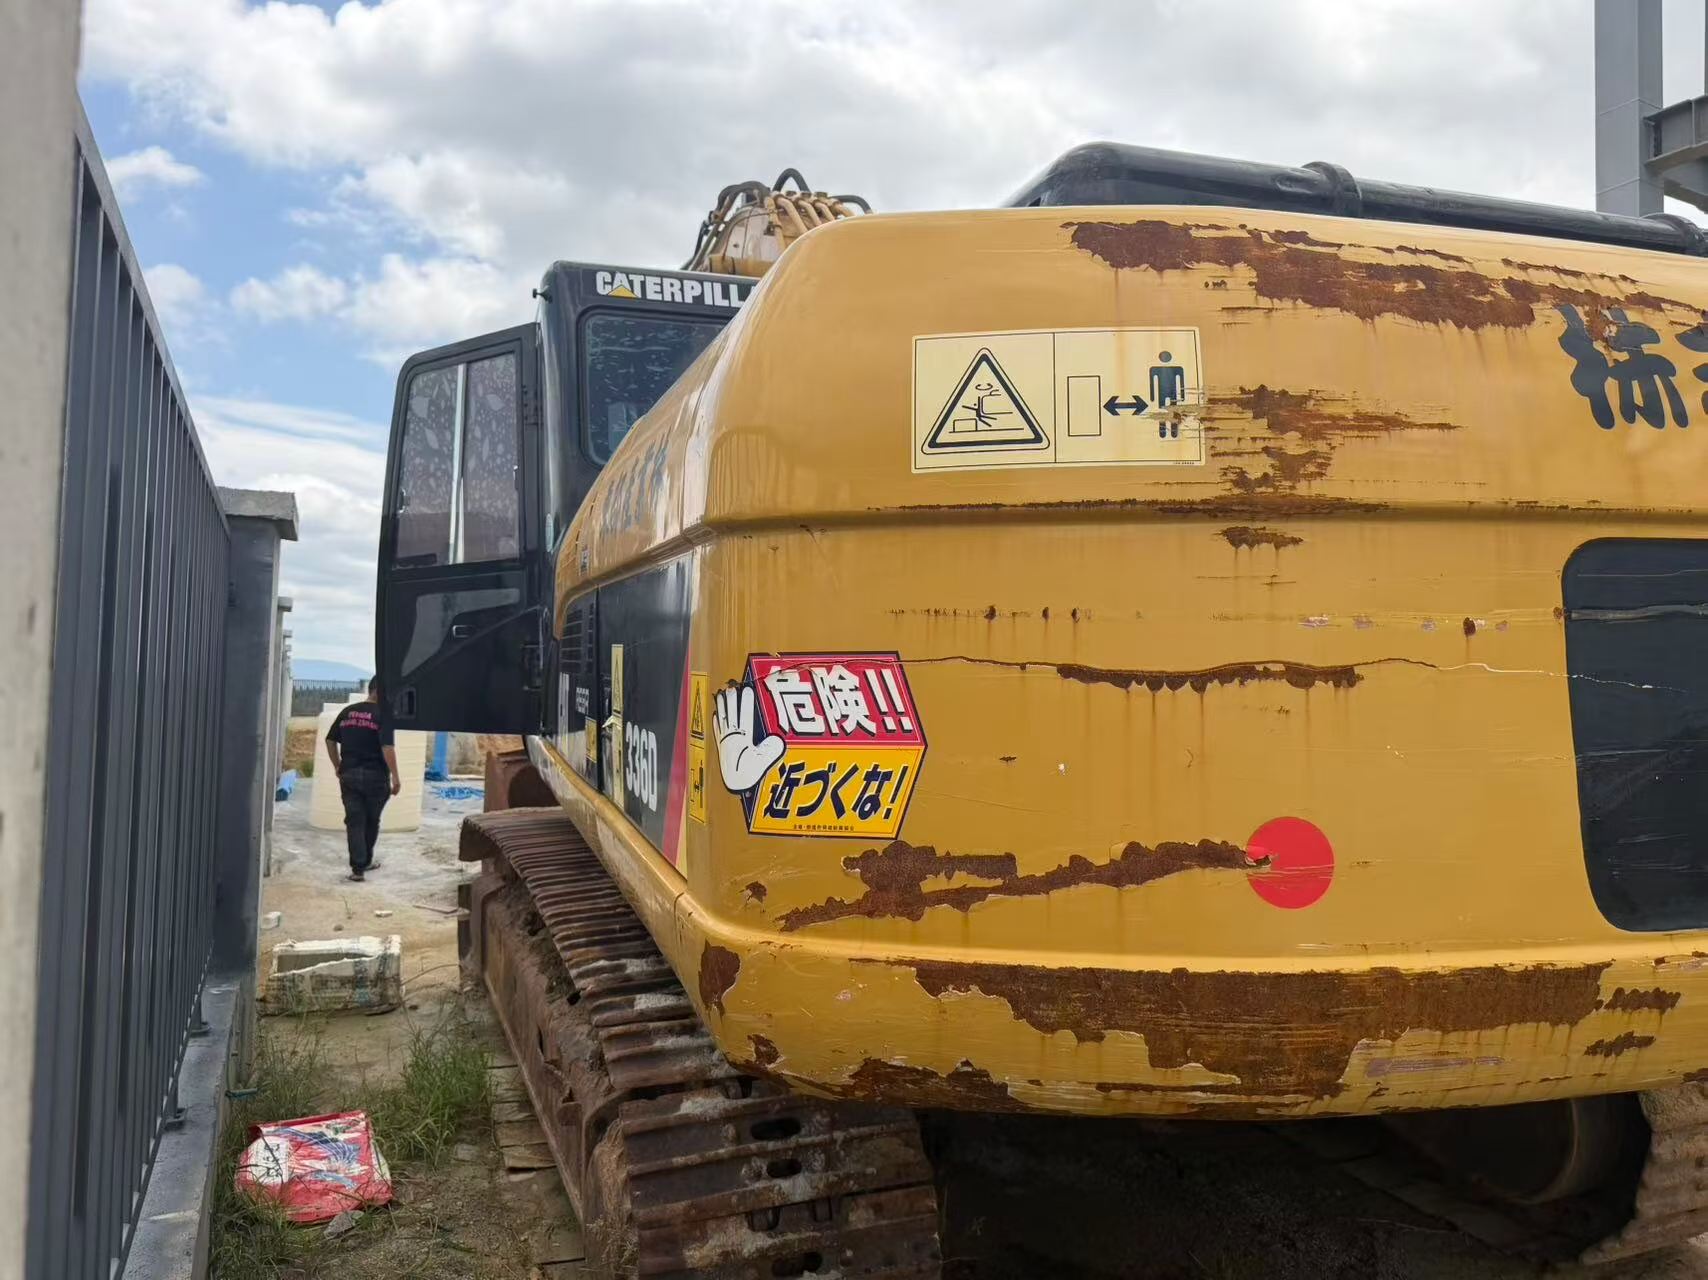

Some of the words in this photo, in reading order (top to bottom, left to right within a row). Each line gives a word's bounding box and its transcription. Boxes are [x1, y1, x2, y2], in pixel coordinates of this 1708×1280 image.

[596, 271, 755, 307] CATERPILL
[625, 721, 658, 812] 336D
[763, 761, 909, 821] 近づくな!
